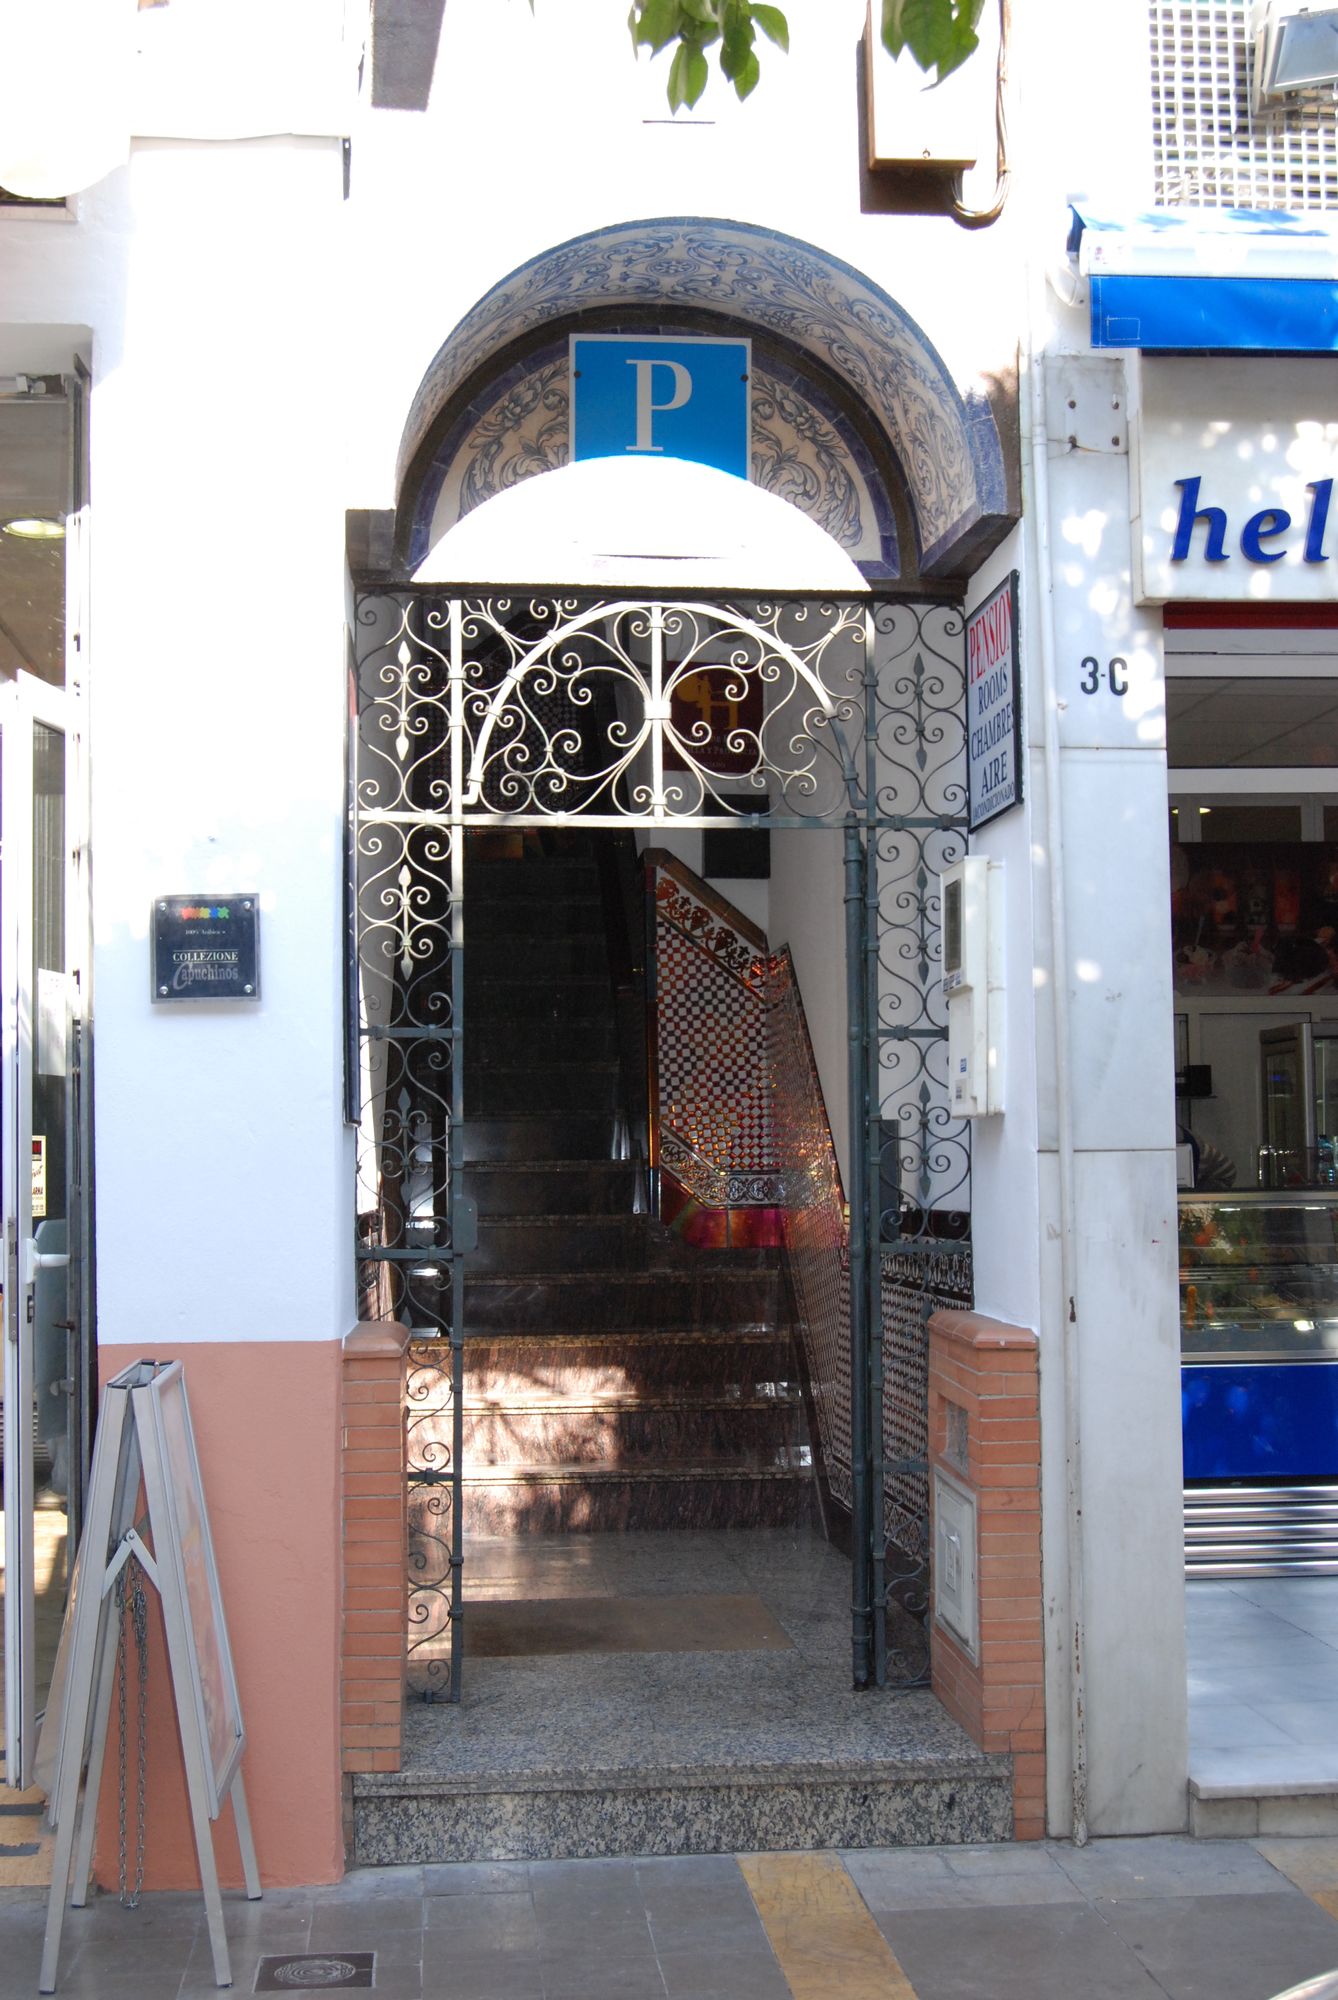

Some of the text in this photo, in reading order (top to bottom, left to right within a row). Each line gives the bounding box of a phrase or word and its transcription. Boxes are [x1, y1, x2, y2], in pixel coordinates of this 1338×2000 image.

[625, 359, 693, 451] P
[1171, 476, 1334, 564] hel
[978, 662, 1008, 715] ROOMS
[981, 751, 1008, 798] AIRE
[173, 951, 239, 961] COLLEZIONE
[173, 961, 239, 990] Capuchinos
